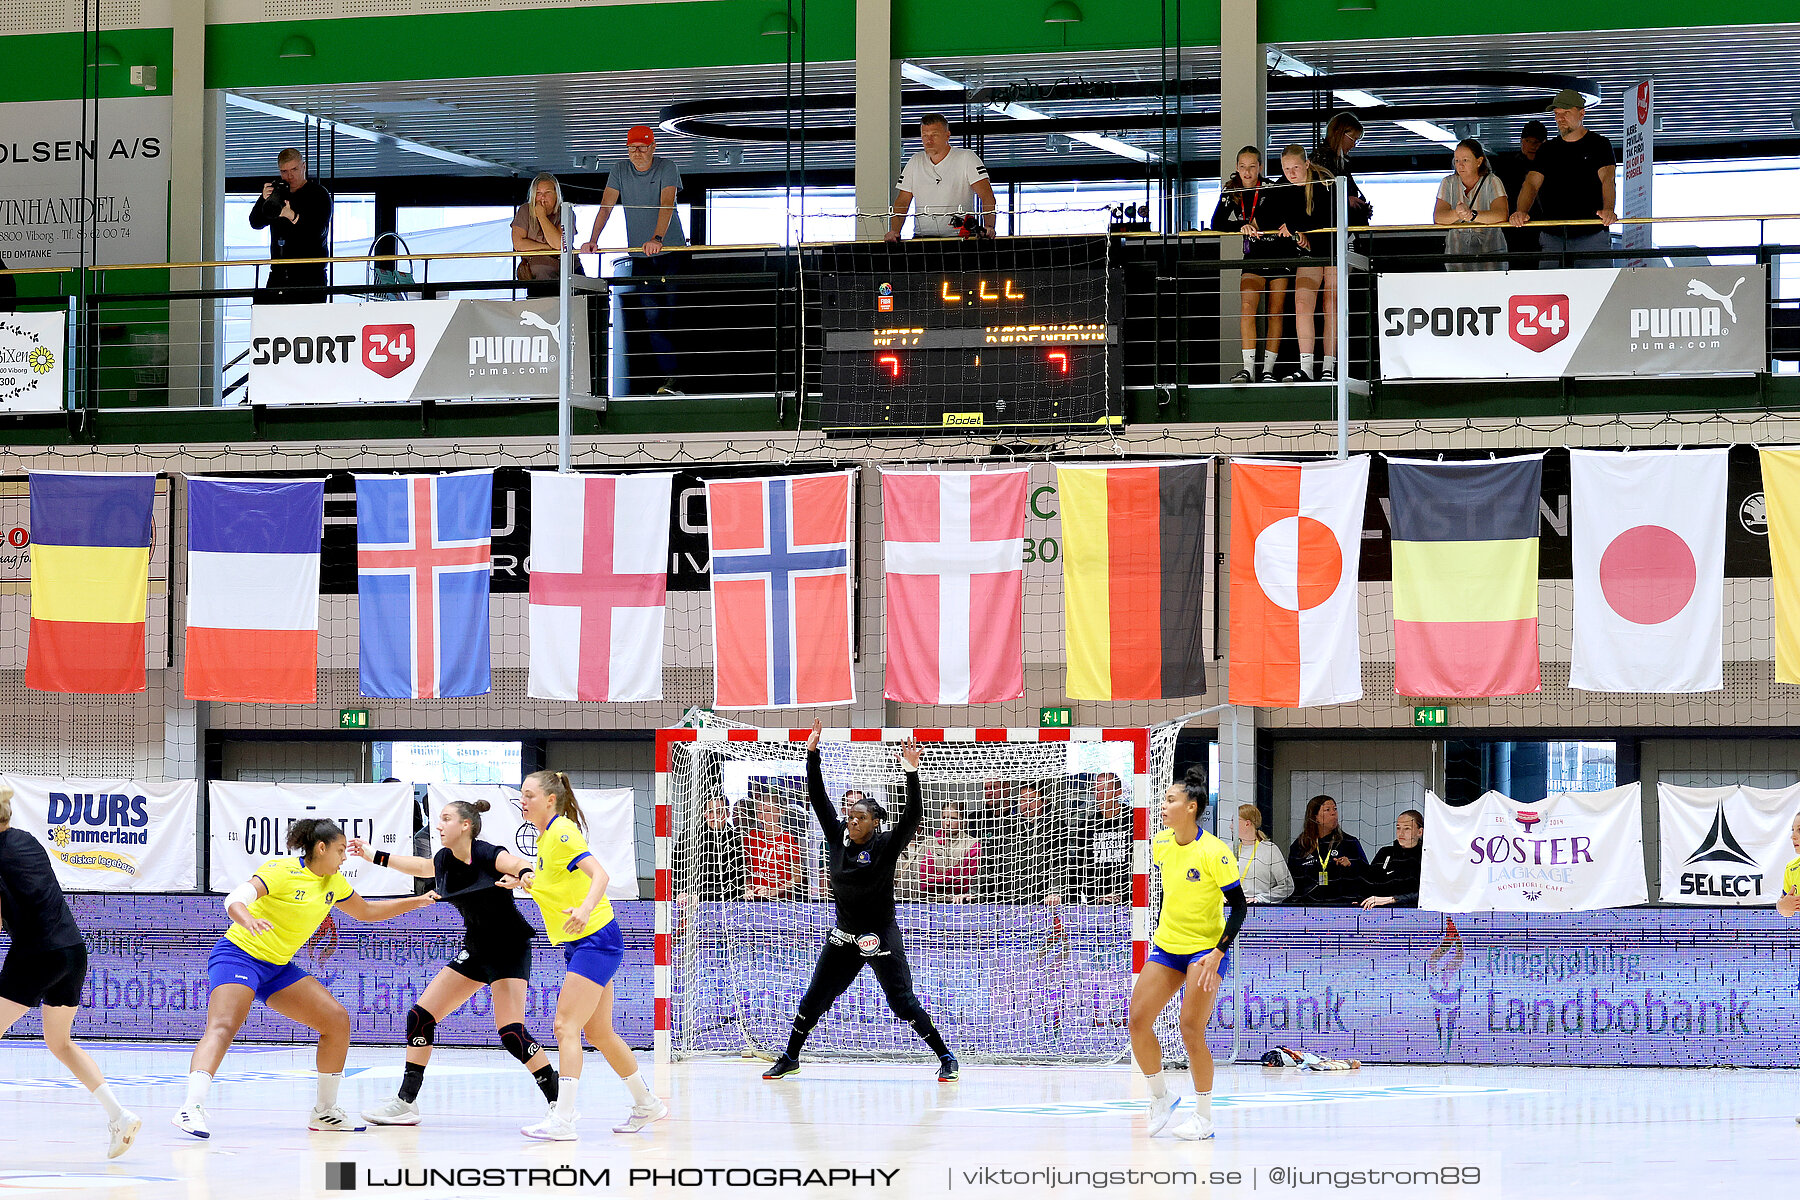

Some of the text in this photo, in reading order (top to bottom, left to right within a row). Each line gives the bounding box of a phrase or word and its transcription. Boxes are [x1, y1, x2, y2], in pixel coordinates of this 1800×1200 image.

[108, 137, 161, 160] A/S
[26, 230, 54, 244] Viborg
[14, 249, 51, 259] OMTANKE
[1384, 304, 1565, 337] SPORT 24
[1630, 306, 1721, 339] PUMA
[253, 334, 412, 366] SPORT 24
[469, 334, 550, 365] PUMA
[1630, 340, 1721, 353] puma.com
[469, 366, 549, 378] puma.com
[945, 414, 982, 426] Bodet
[47, 792, 149, 828] DJURS
[1470, 834, 1594, 866] SØSTER
[70, 855, 97, 865] elsker
[98, 855, 136, 876] legebørn
[1487, 866, 1574, 885] LAGKAGE
[294, 889, 306, 901] 27
[1680, 872, 1763, 897] SELECT
[858, 938, 878, 948] cora
[1486, 946, 1642, 982] Ringkjøbing
[1486, 988, 1750, 1035] Landbobank
